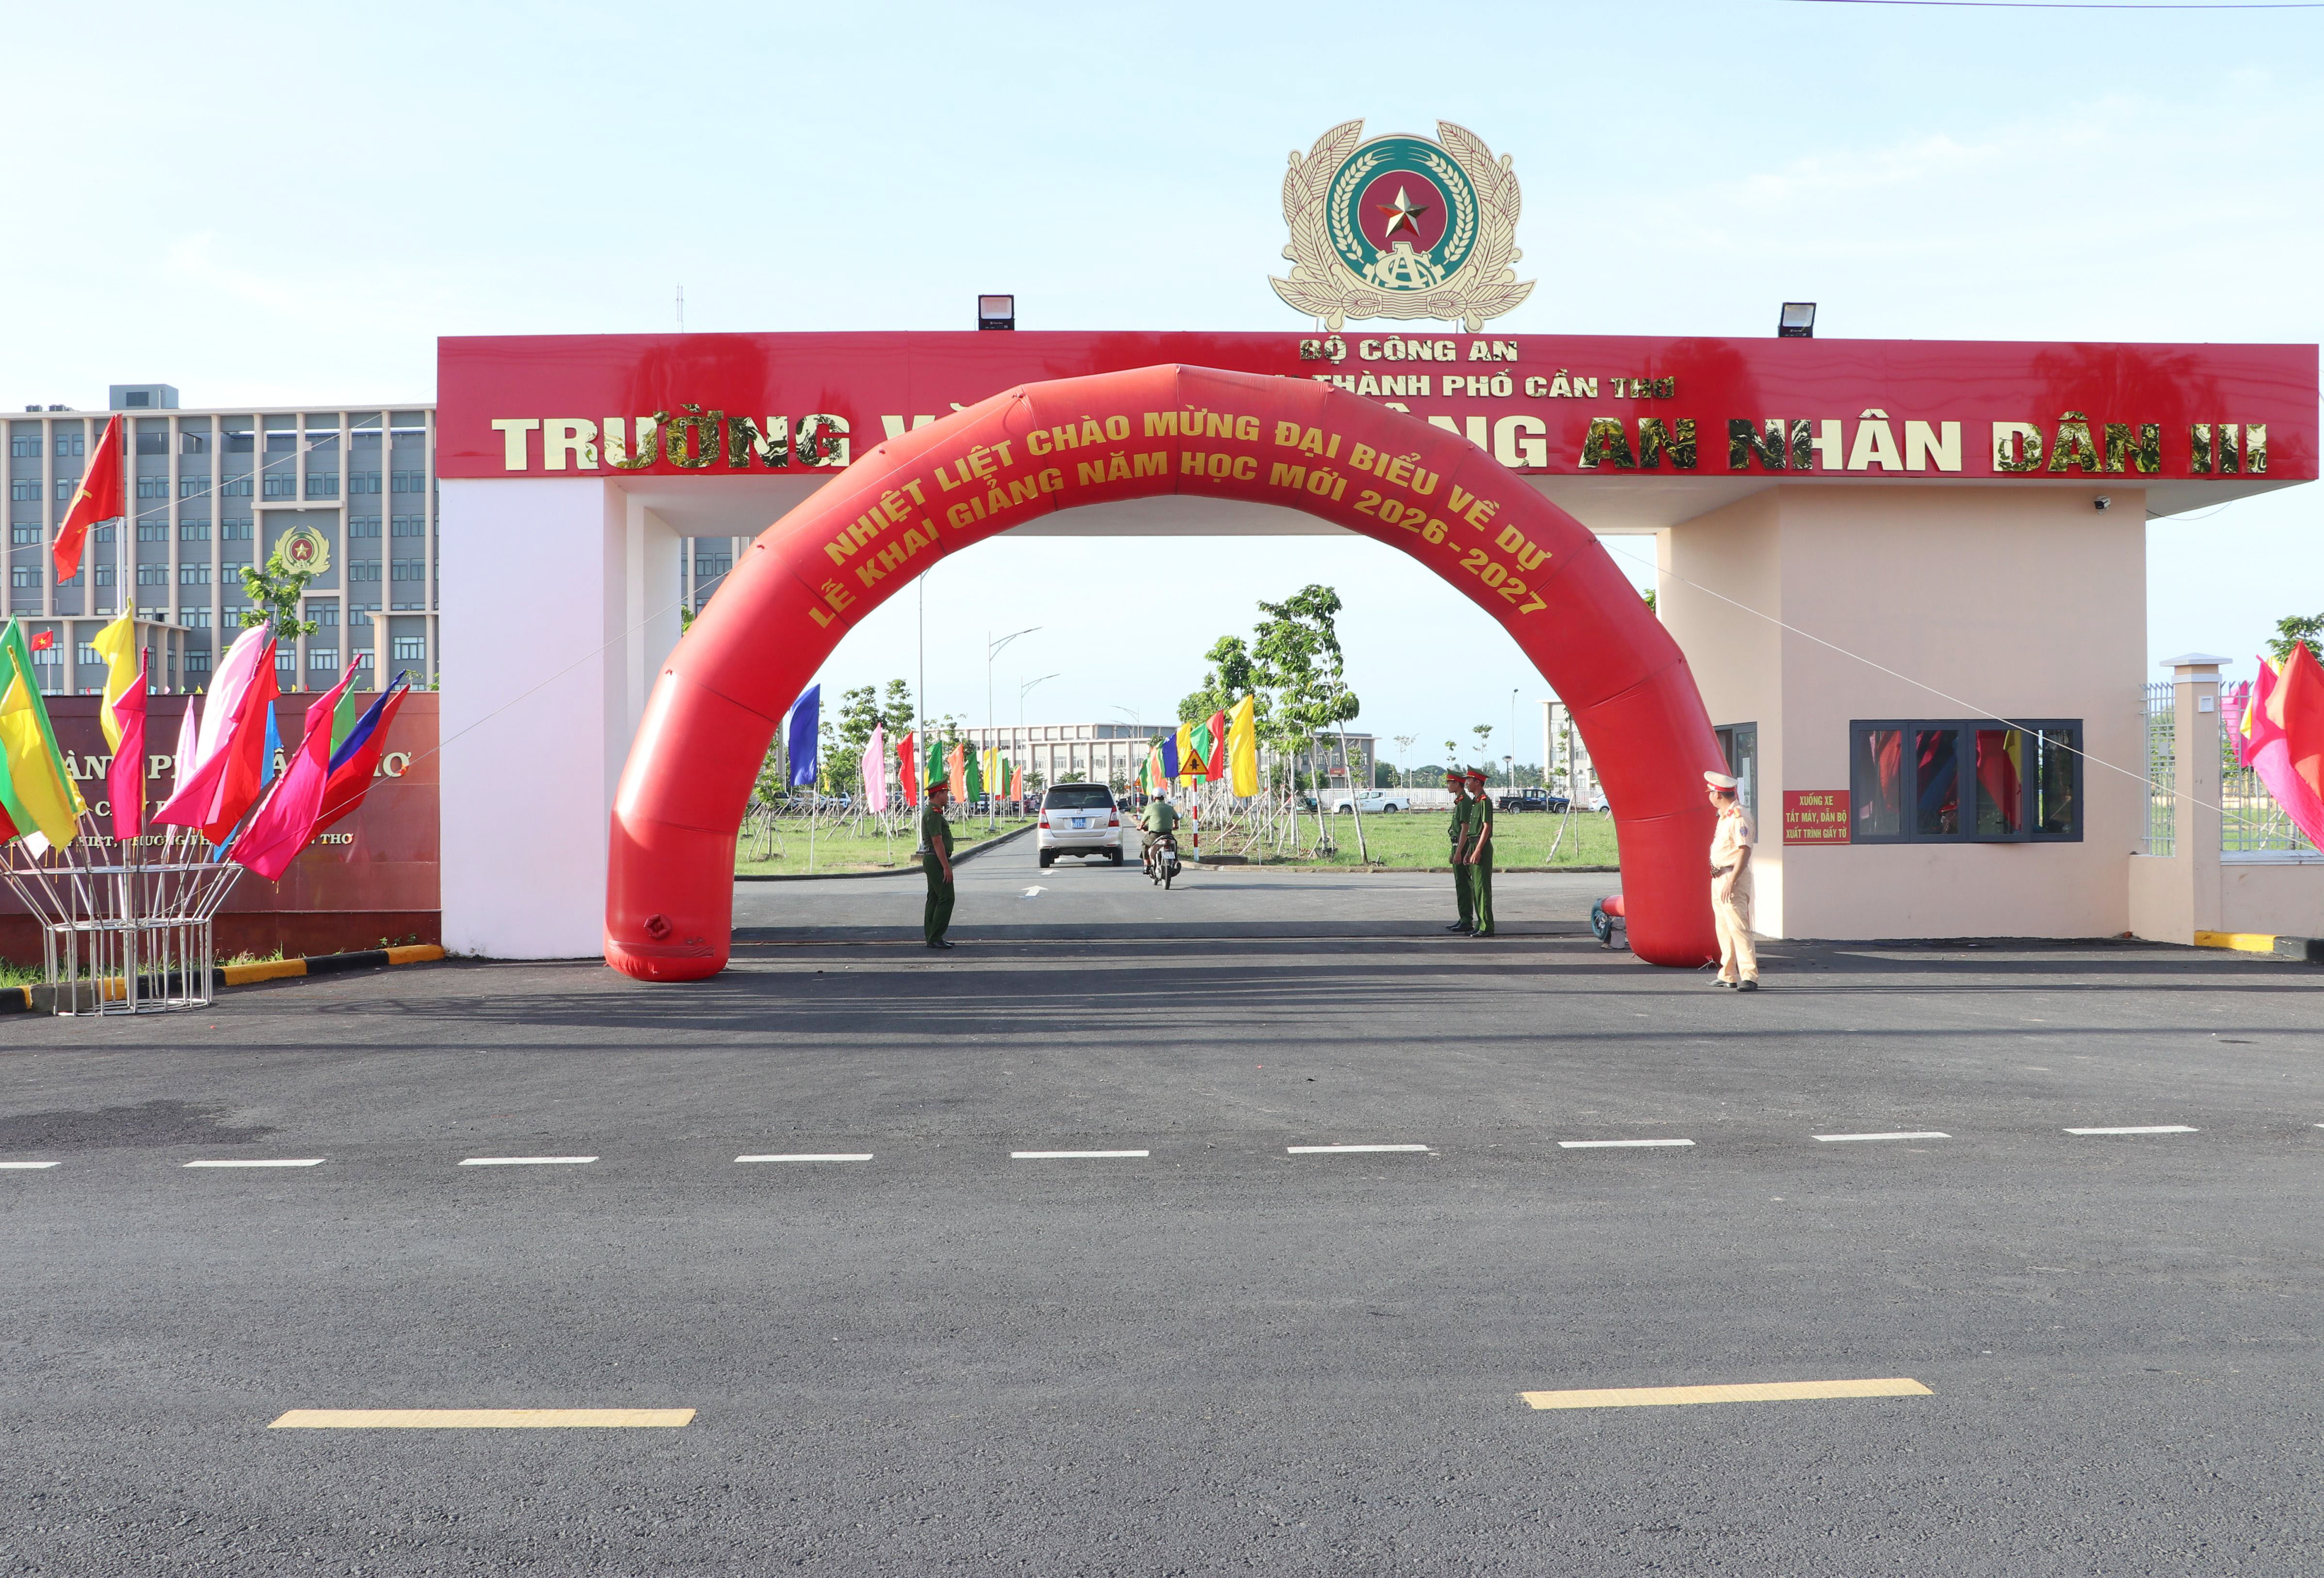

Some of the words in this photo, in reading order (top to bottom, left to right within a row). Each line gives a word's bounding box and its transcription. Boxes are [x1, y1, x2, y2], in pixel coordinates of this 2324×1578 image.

[1300, 335, 1347, 364] BỘ
[1359, 335, 1456, 362] CÔNG
[1468, 340, 1517, 362] AN
[1442, 368, 1514, 397] PHỐ
[1525, 368, 1598, 398] CẦN
[1609, 376, 1676, 399] THƠ
[492, 404, 850, 471] TRƯỜNG
[1578, 417, 1696, 469] AN
[1728, 408, 1962, 471] NHÂN
[1992, 411, 2160, 473] DÂN
[2190, 423, 2267, 473] III
[823, 478, 926, 566] NHIỆT
[934, 439, 1013, 492] LIỆT
[1027, 415, 1130, 456] CHÀO
[1144, 404, 1260, 441] MỪNG
[1275, 421, 1341, 458] ĐẠI
[1349, 442, 1439, 495] BIỂU
[1447, 484, 1500, 532] VỀ
[1495, 524, 1553, 572] DỰ
[808, 578, 857, 629] LỄ
[855, 518, 940, 588] KHAI
[947, 468, 1064, 529] GIẢNG
[1077, 451, 1168, 486] NĂM
[1180, 451, 1258, 483] HỌC
[1269, 462, 1348, 502] MỚI
[1799, 792, 1823, 806] XUỐNG
[1824, 796, 1834, 806] XE
[1786, 808, 1799, 822] TẮT
[1801, 810, 1819, 824] MÁY,
[1821, 808, 1835, 822] DẪN
[1837, 810, 1847, 824] BỘ
[320, 833, 354, 844] THƠ
[1786, 826, 1802, 838] XUẤT
[1803, 827, 1822, 838] TRÌNH
[1823, 825, 1837, 838] GIẤY
[1839, 826, 1847, 838] TỜ
